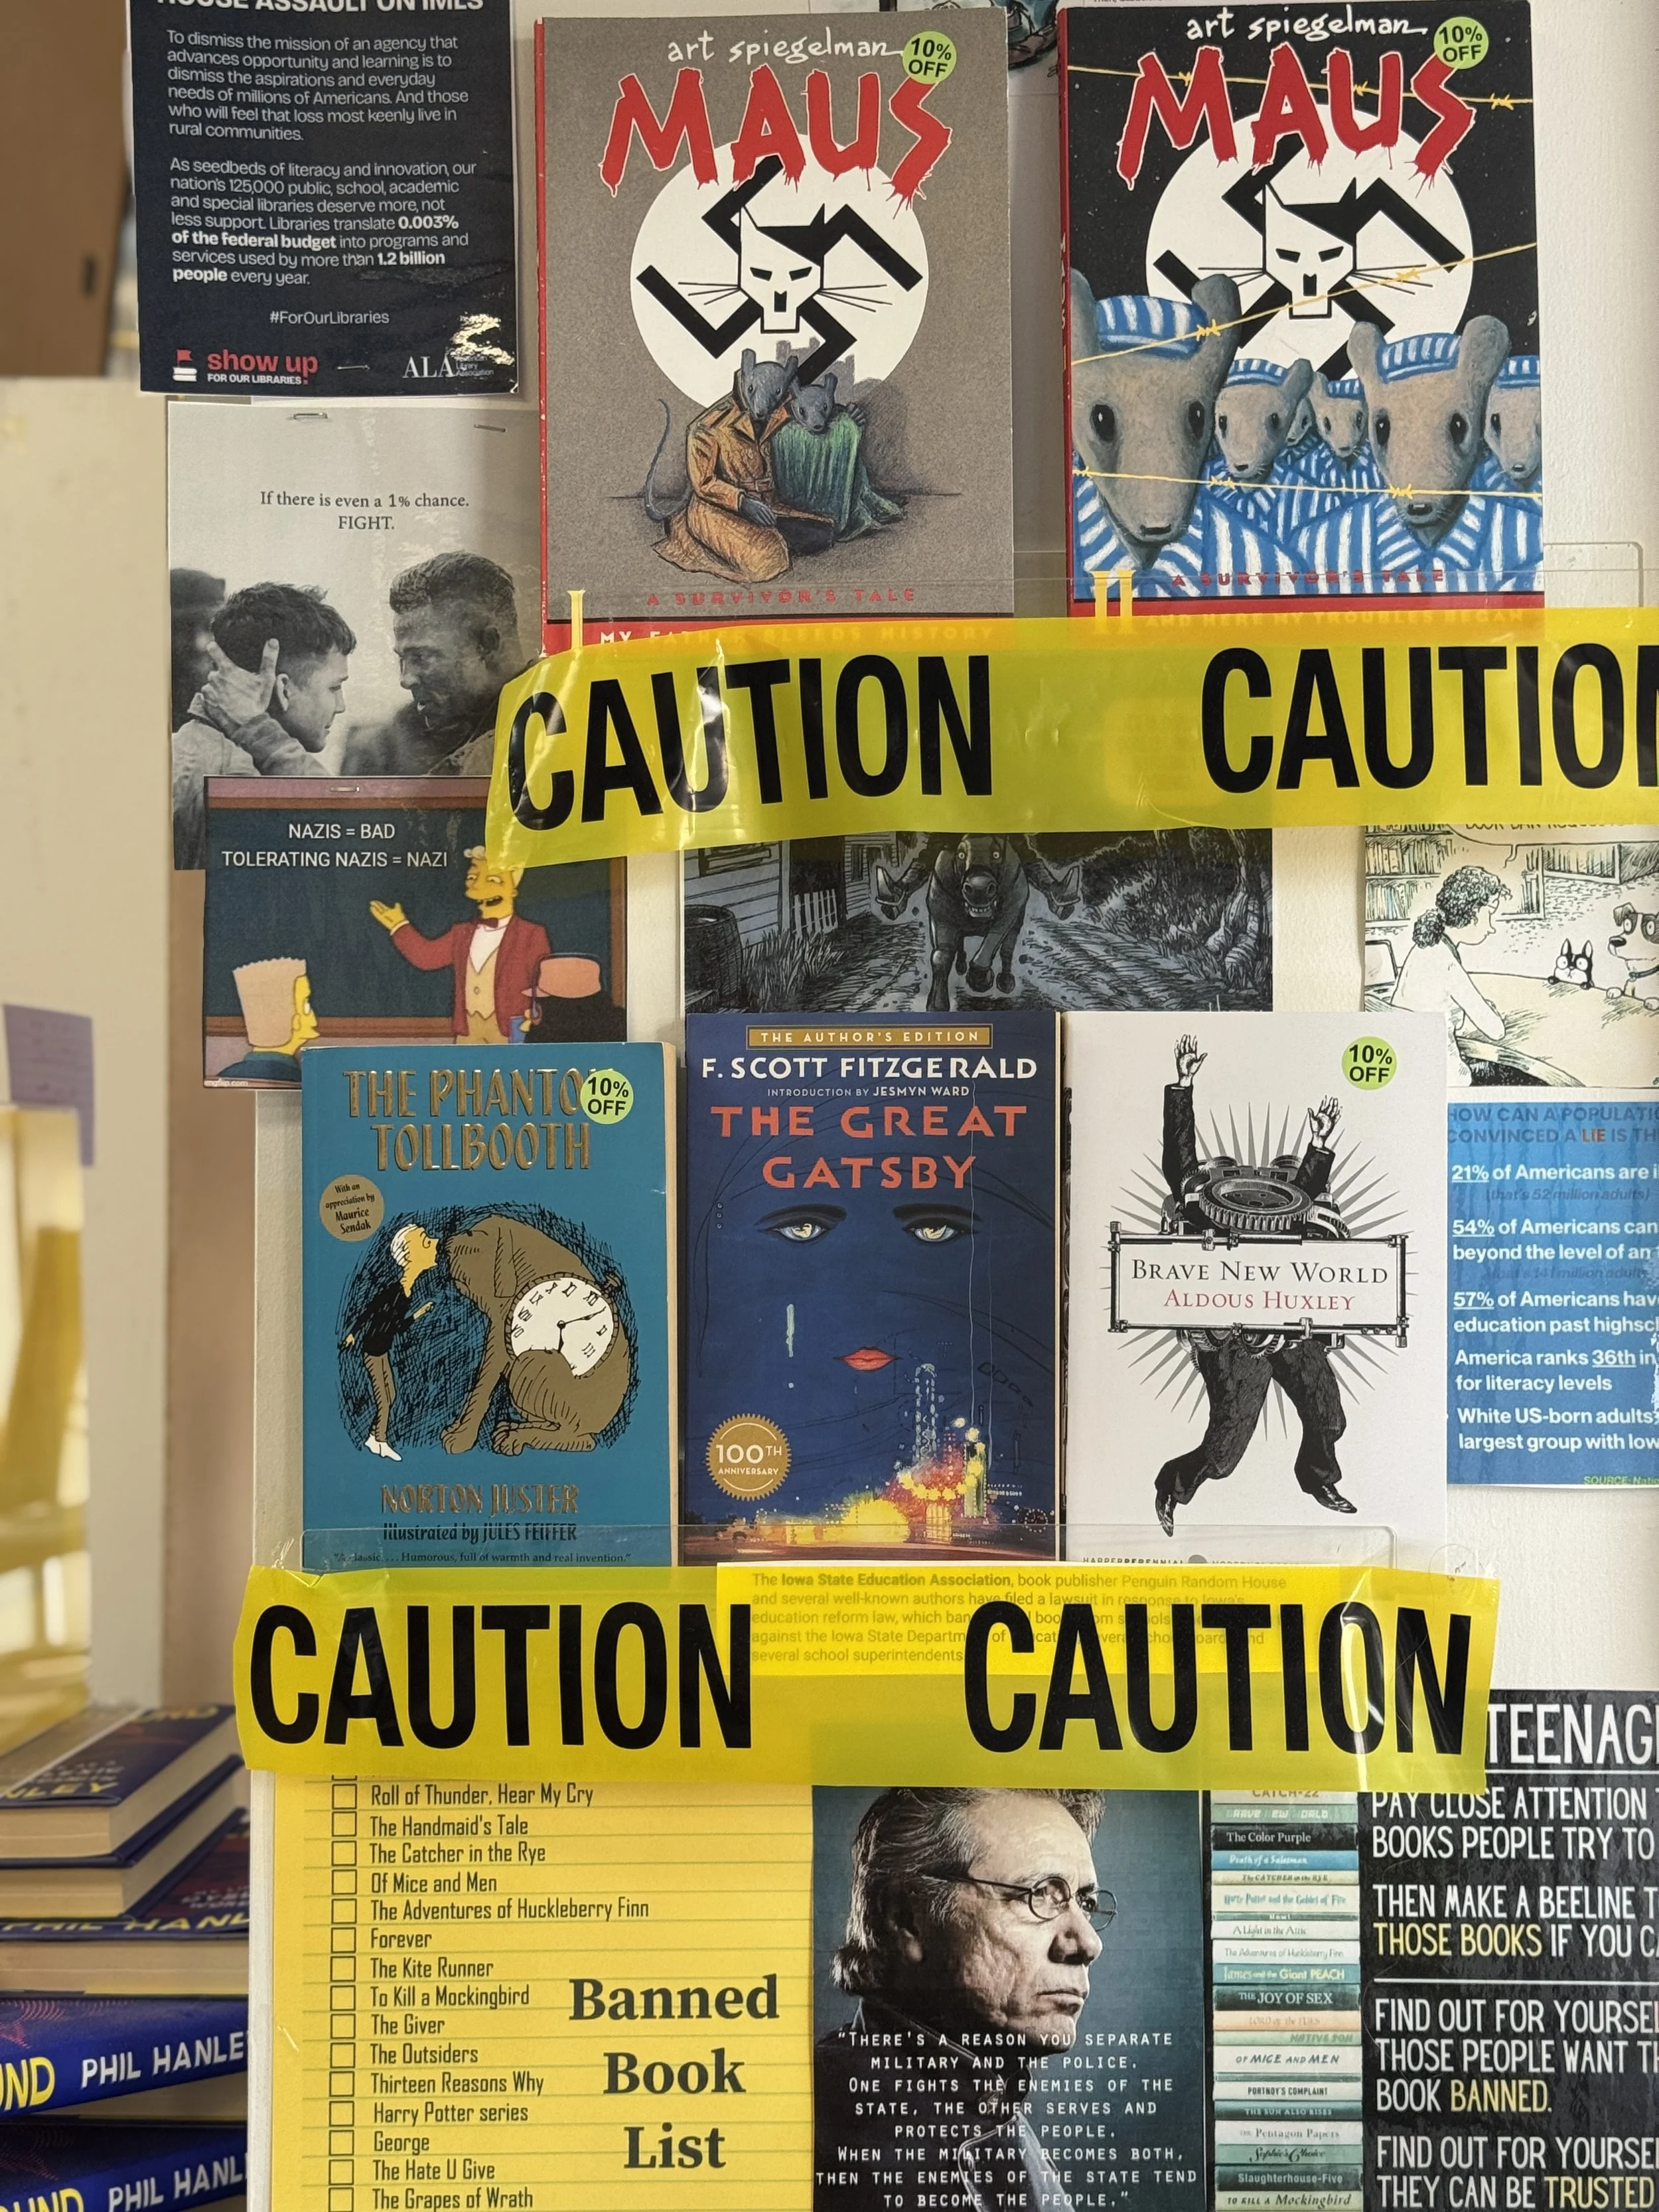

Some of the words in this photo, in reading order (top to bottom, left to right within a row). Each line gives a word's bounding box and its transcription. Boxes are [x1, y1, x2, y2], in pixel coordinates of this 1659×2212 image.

[1187, 10, 1235, 40] art
[1248, 4, 1427, 42] spiegelman
[167, 31, 184, 44] To
[188, 33, 244, 47] dismiss
[247, 35, 271, 49] the
[275, 37, 330, 50] mission
[334, 37, 350, 50] of
[352, 38, 370, 50] an
[374, 37, 427, 53] agency
[429, 35, 457, 50] that
[1439, 26, 1482, 45] 10%
[668, 30, 714, 62] art
[729, 27, 903, 65] spiegelman
[910, 38, 951, 61] 10%
[1443, 44, 1481, 62] OFF
[908, 59, 948, 78] OFF
[1116, 41, 1476, 197] MAUS
[599, 63, 952, 210] MAUS
[171, 213, 201, 228] less
[205, 216, 265, 231] support.
[270, 216, 329, 231] Libraries
[333, 217, 395, 230] translate
[398, 216, 459, 230] 0.003%
[270, 311, 390, 326] #ForOurLibraries
[208, 350, 278, 372] show
[286, 354, 318, 377] up
[403, 356, 453, 378] ALA
[208, 374, 225, 383] FOR
[252, 375, 301, 384] LIBRARIES
[261, 491, 274, 504] If
[277, 492, 315, 506] there
[319, 494, 331, 506] is
[336, 497, 369, 508] even
[374, 498, 382, 507] a
[389, 494, 411, 508] 1%
[415, 494, 469, 508] chance.
[338, 516, 396, 530] FIGHT.
[1171, 576, 1185, 587] A
[1200, 570, 1364, 586] SURVIVOR'S
[1383, 569, 1443, 583] TALE
[647, 594, 659, 605] A
[675, 589, 835, 605] SURVIVOR'S
[855, 588, 915, 602] TALE
[600, 631, 632, 644] MY
[508, 654, 992, 830] CAUTION
[289, 824, 341, 839] NAZIS
[360, 824, 396, 839] BAD
[222, 851, 330, 867] TOLERATING
[336, 852, 387, 867] NAZIS
[407, 853, 447, 867] NAZI
[760, 1032, 792, 1043] THE
[804, 1031, 893, 1042] AUTHOR'S
[903, 1031, 978, 1041] EDITION
[1348, 1045, 1392, 1065] 10%
[703, 1059, 723, 1078] F.
[731, 1057, 827, 1078] SCOTT
[841, 1056, 1037, 1078] FITZGERALD
[1349, 1067, 1390, 1082] OFF
[342, 1070, 417, 1118] THE
[430, 1068, 597, 1116] PHANTO
[587, 1077, 629, 1098] 10%
[873, 1086, 926, 1096] JESMYN
[931, 1086, 969, 1096] WARD
[587, 1100, 626, 1116] OFF
[710, 1106, 814, 1138] THE
[841, 1106, 1027, 1138] GREAT
[370, 1122, 591, 1171] TOLLBOOTH
[762, 1156, 976, 1189] GATSBY
[1452, 1165, 1488, 1181] 21%
[1493, 1165, 1512, 1180] of
[1515, 1164, 1615, 1180] Americans
[1619, 1165, 1648, 1180] are
[334, 1184, 350, 1193] With
[326, 1195, 366, 1209] appreciation
[366, 1193, 375, 1202] by
[335, 1207, 370, 1221] Maurice
[340, 1219, 371, 1234] Sendak
[1455, 1350, 1532, 1365] America
[1537, 1350, 1588, 1364] ranks
[1592, 1349, 1636, 1366] 36th
[1640, 1351, 1655, 1364] in
[1456, 1375, 1482, 1390] for
[1486, 1375, 1554, 1394] literacy
[1559, 1375, 1612, 1390] levels
[715, 1444, 782, 1464] 100TH
[381, 1484, 482, 1514] NORTON
[491, 1485, 579, 1518] JUSTER
[384, 1523, 457, 1541] Illustrated
[462, 1524, 479, 1543] by
[482, 1523, 521, 1542] JULES
[526, 1523, 577, 1541] FEIFFER
[752, 1574, 778, 1587] The
[781, 1574, 814, 1586] Iowa
[818, 1574, 853, 1587] State
[858, 1574, 925, 1587] Education
[930, 1574, 1013, 1588] Association,
[1018, 1574, 1051, 1586] book
[1055, 1574, 1118, 1591] publisher
[1121, 1574, 1176, 1592] Penguin
[1181, 1576, 1238, 1588] Random
[1242, 1576, 1286, 1588] House
[250, 1602, 752, 1749] CAUTION
[964, 1601, 1472, 1756] CAUTION
[1488, 1704, 1659, 1764] TEENAG
[371, 1783, 398, 1806] Roll
[404, 1783, 419, 1805] of
[424, 1783, 492, 1805] Thunder,
[498, 1783, 535, 1804] Hear
[540, 1783, 561, 1806] My
[567, 1785, 593, 1806] Cry
[1226, 1832, 1246, 1842] The
[1248, 1832, 1275, 1842] Color
[1277, 1832, 1311, 1844] Purple
[1373, 1826, 1453, 1858] BOOKS
[1462, 1826, 1554, 1859] PEOPLE
[1562, 1826, 1613, 1860] TRY
[1622, 1826, 1654, 1860] TO
[370, 1927, 432, 1949] Forever
[1373, 1923, 1452, 1956] THOSE
[1461, 1923, 1542, 1957] BOOKS
[1550, 1924, 1571, 1957] IF
[1581, 1925, 1632, 1958] YOU
[569, 1973, 780, 2021] Banned
[938, 2034, 948, 2045] A
[962, 2034, 1027, 2045] REASON
[1040, 2033, 1072, 2045] YOU
[1085, 2033, 1173, 2045] SEPARATE
[80, 2051, 141, 2089] PHIL
[152, 2031, 249, 2075] HANLE
[1250, 2055, 1281, 2064] MICE
[1309, 2055, 1339, 2064] MEN
[603, 2047, 746, 2095] Book
[1376, 2079, 1441, 2112] BOOK
[1451, 2079, 1551, 2112] BANNED.
[374, 2102, 418, 2126] Harry
[424, 2101, 474, 2123] Potter
[480, 2103, 528, 2121] series
[374, 2130, 430, 2154] George
[624, 2122, 726, 2169] List
[1238, 2174, 1342, 2184] Slaughterhouse-Five
